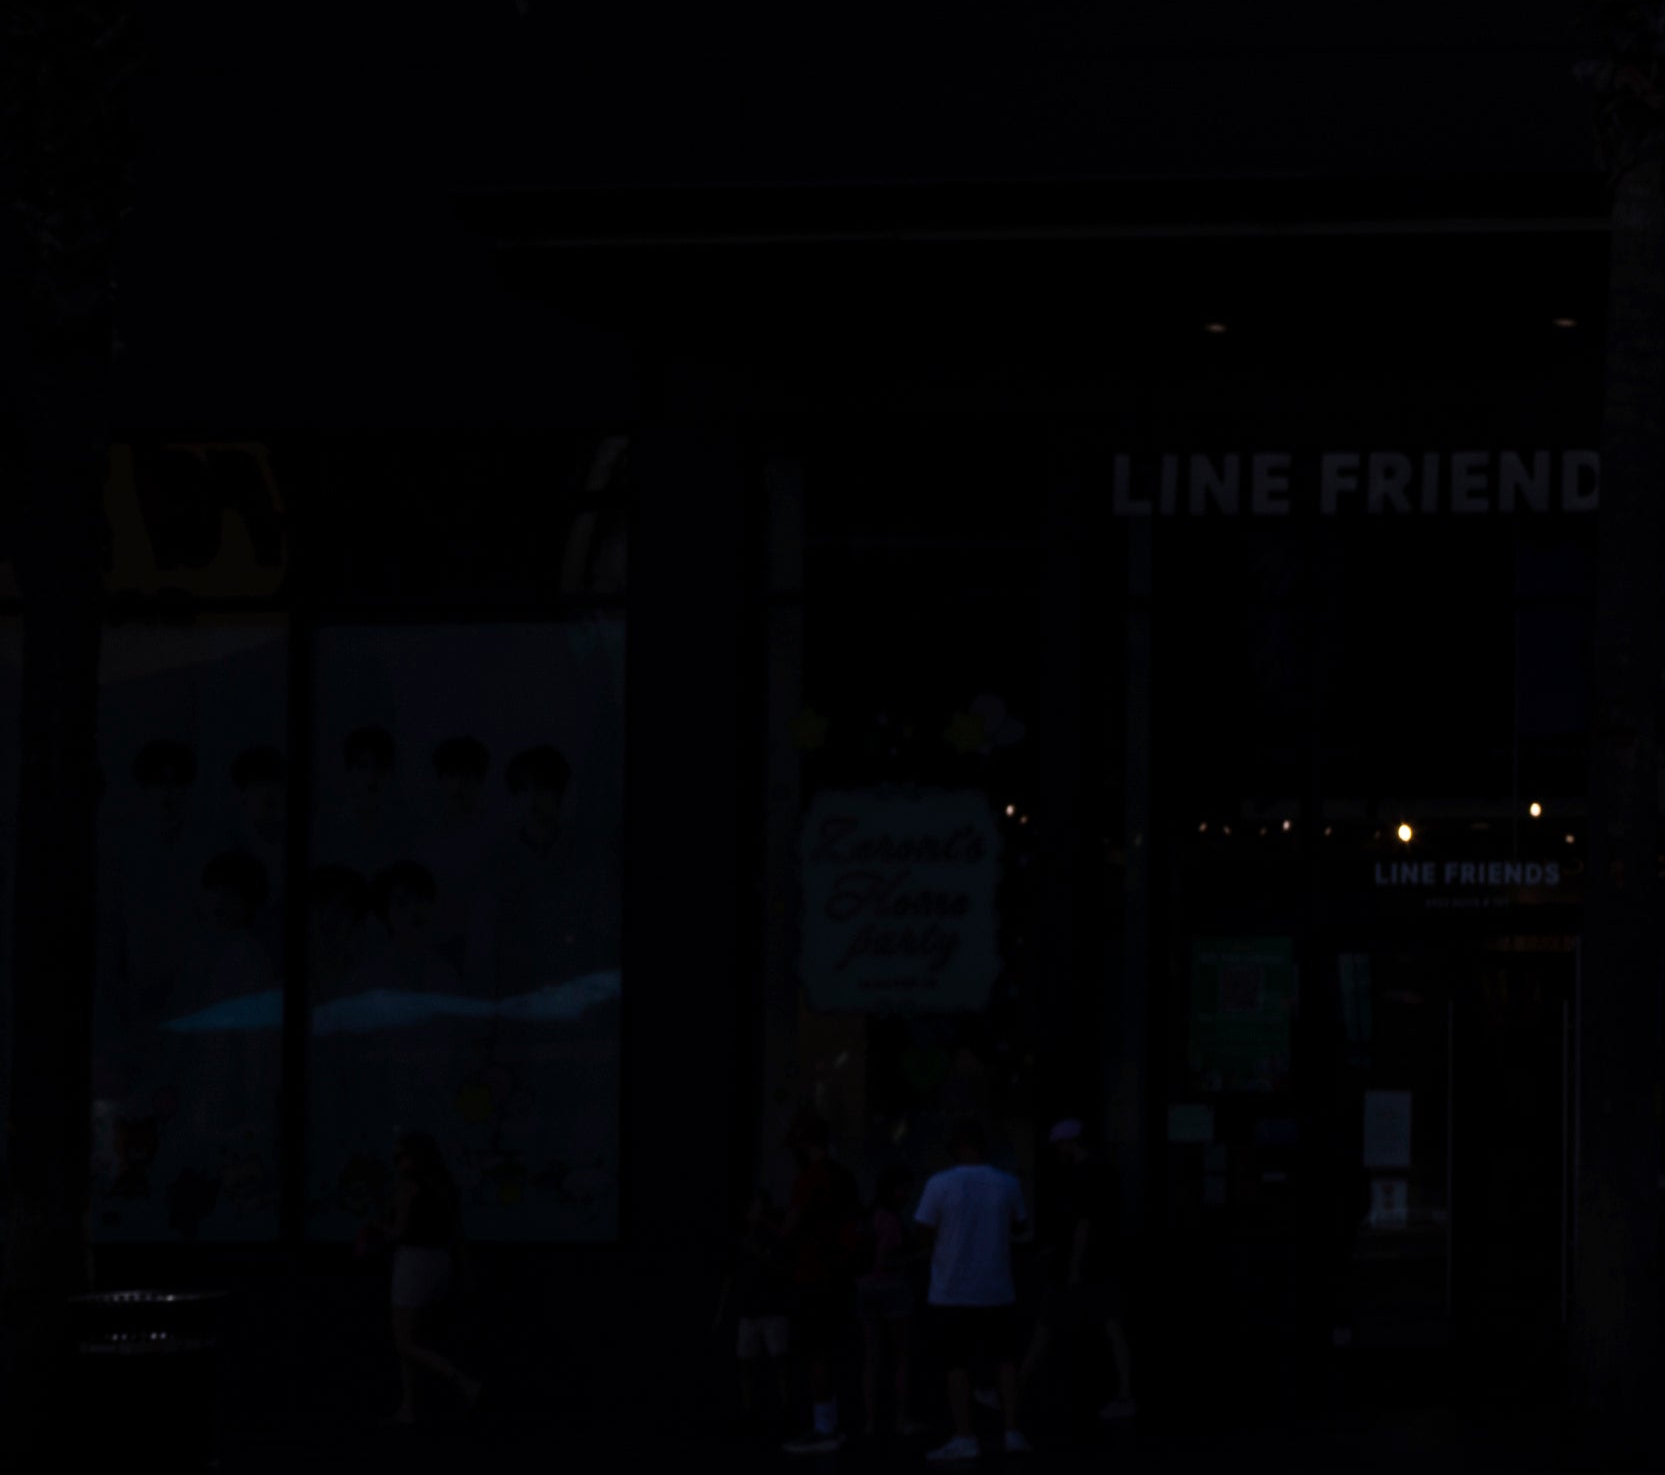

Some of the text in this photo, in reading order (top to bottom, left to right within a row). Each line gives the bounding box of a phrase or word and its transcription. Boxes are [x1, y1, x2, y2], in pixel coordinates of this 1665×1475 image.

[1111, 449, 1601, 516] LINE FRIEND
[1375, 860, 1561, 887] LINE FRIENDS
